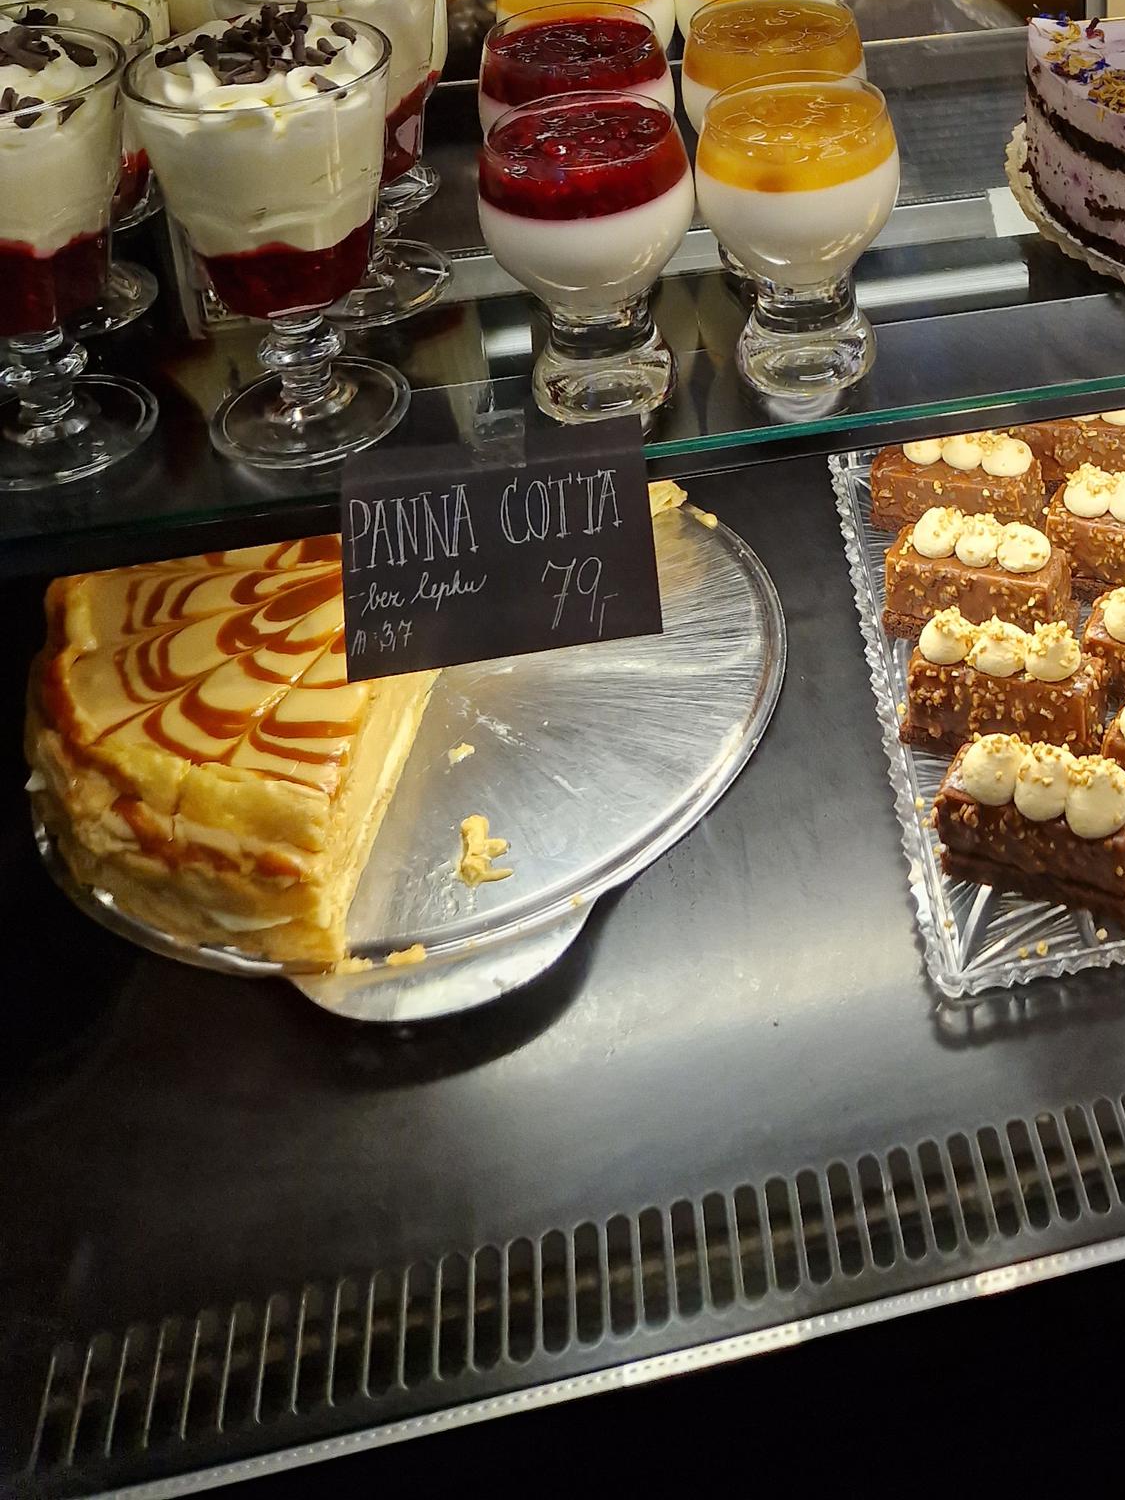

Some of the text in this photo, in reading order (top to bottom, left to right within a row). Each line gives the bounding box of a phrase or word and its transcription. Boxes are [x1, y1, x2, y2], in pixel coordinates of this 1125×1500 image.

[348, 468, 624, 573] PANNA COTTA
[410, 570, 488, 612] lepku
[541, 556, 620, 637] 79,-
